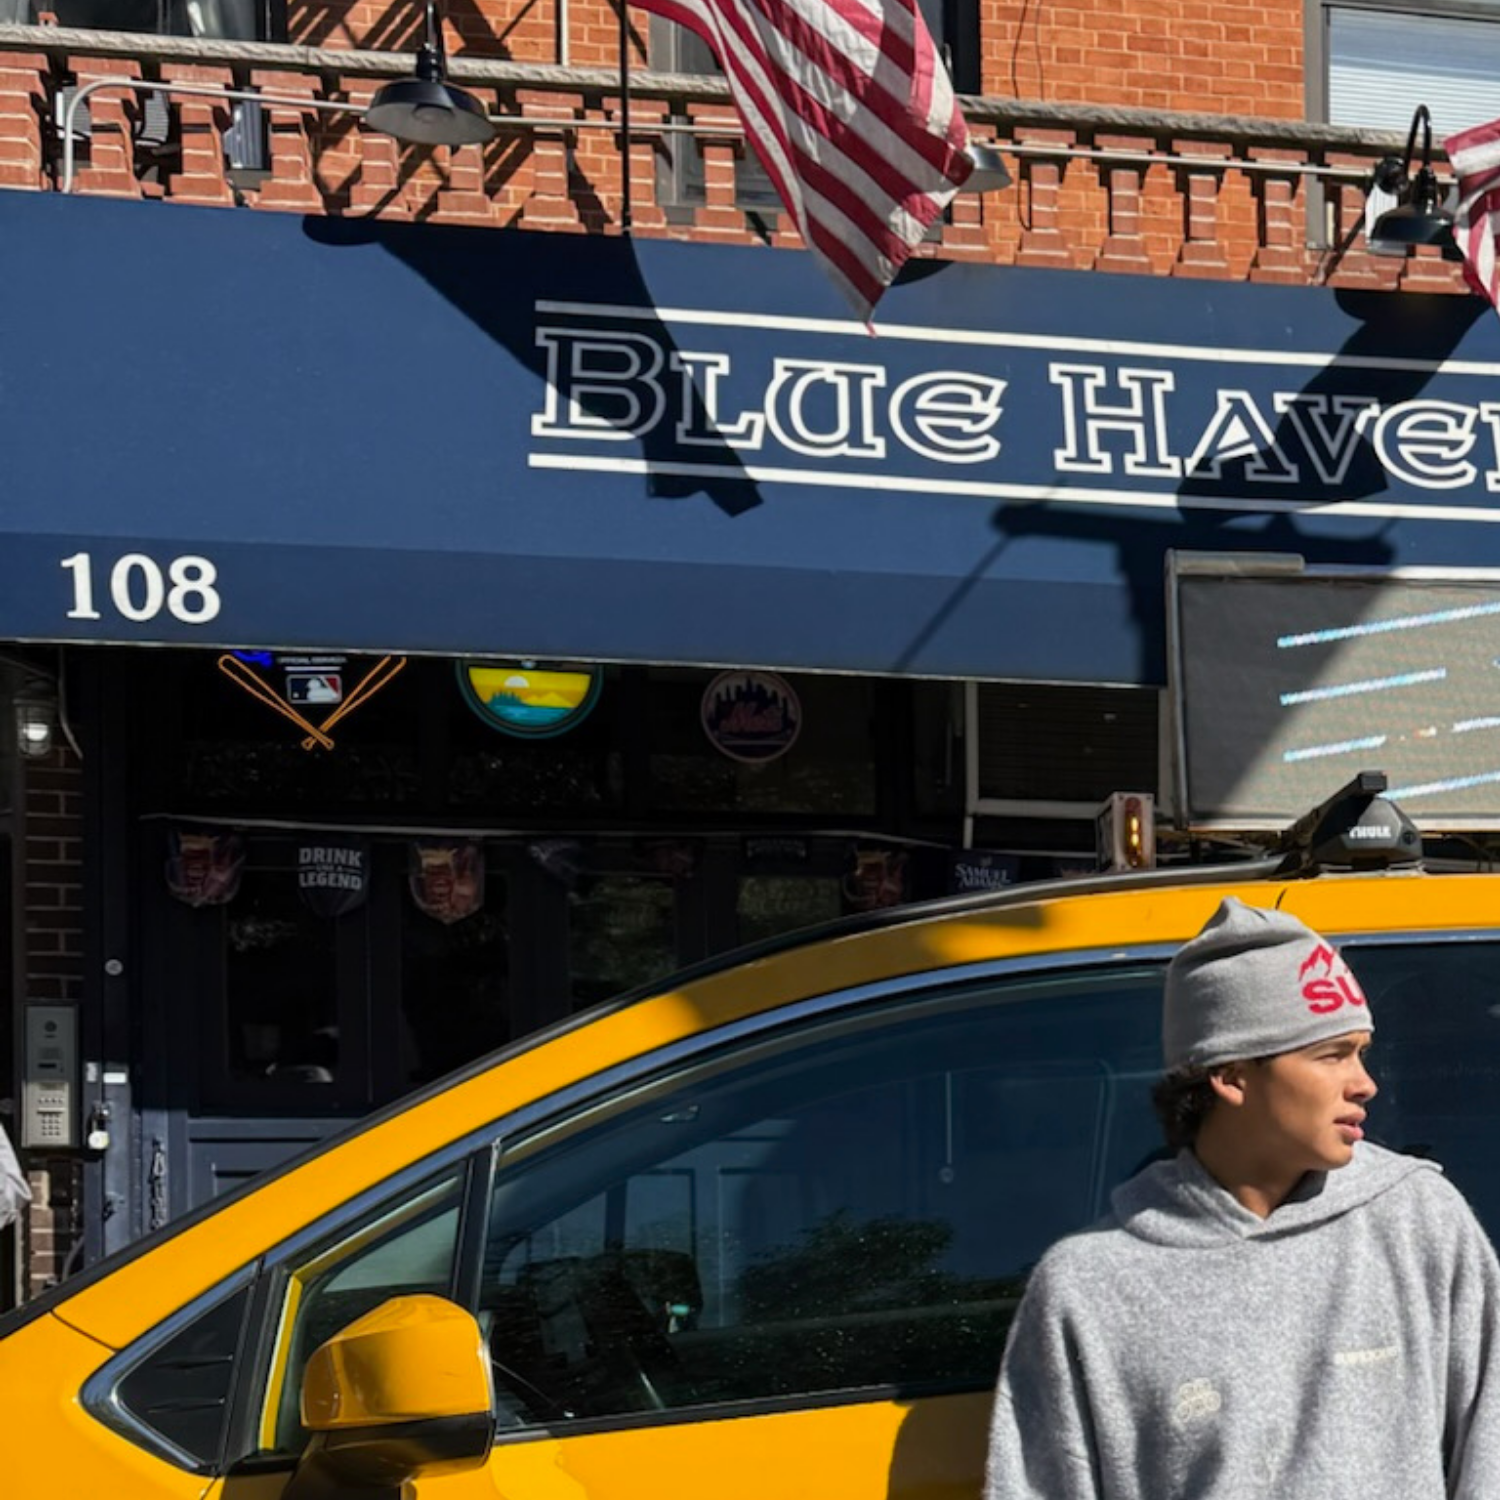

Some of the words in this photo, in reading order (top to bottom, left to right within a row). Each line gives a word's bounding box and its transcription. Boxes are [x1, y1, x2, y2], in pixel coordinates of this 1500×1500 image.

[60, 552, 222, 625] 108
[298, 846, 362, 867] DRINK
[298, 871, 362, 890] LEGEND
